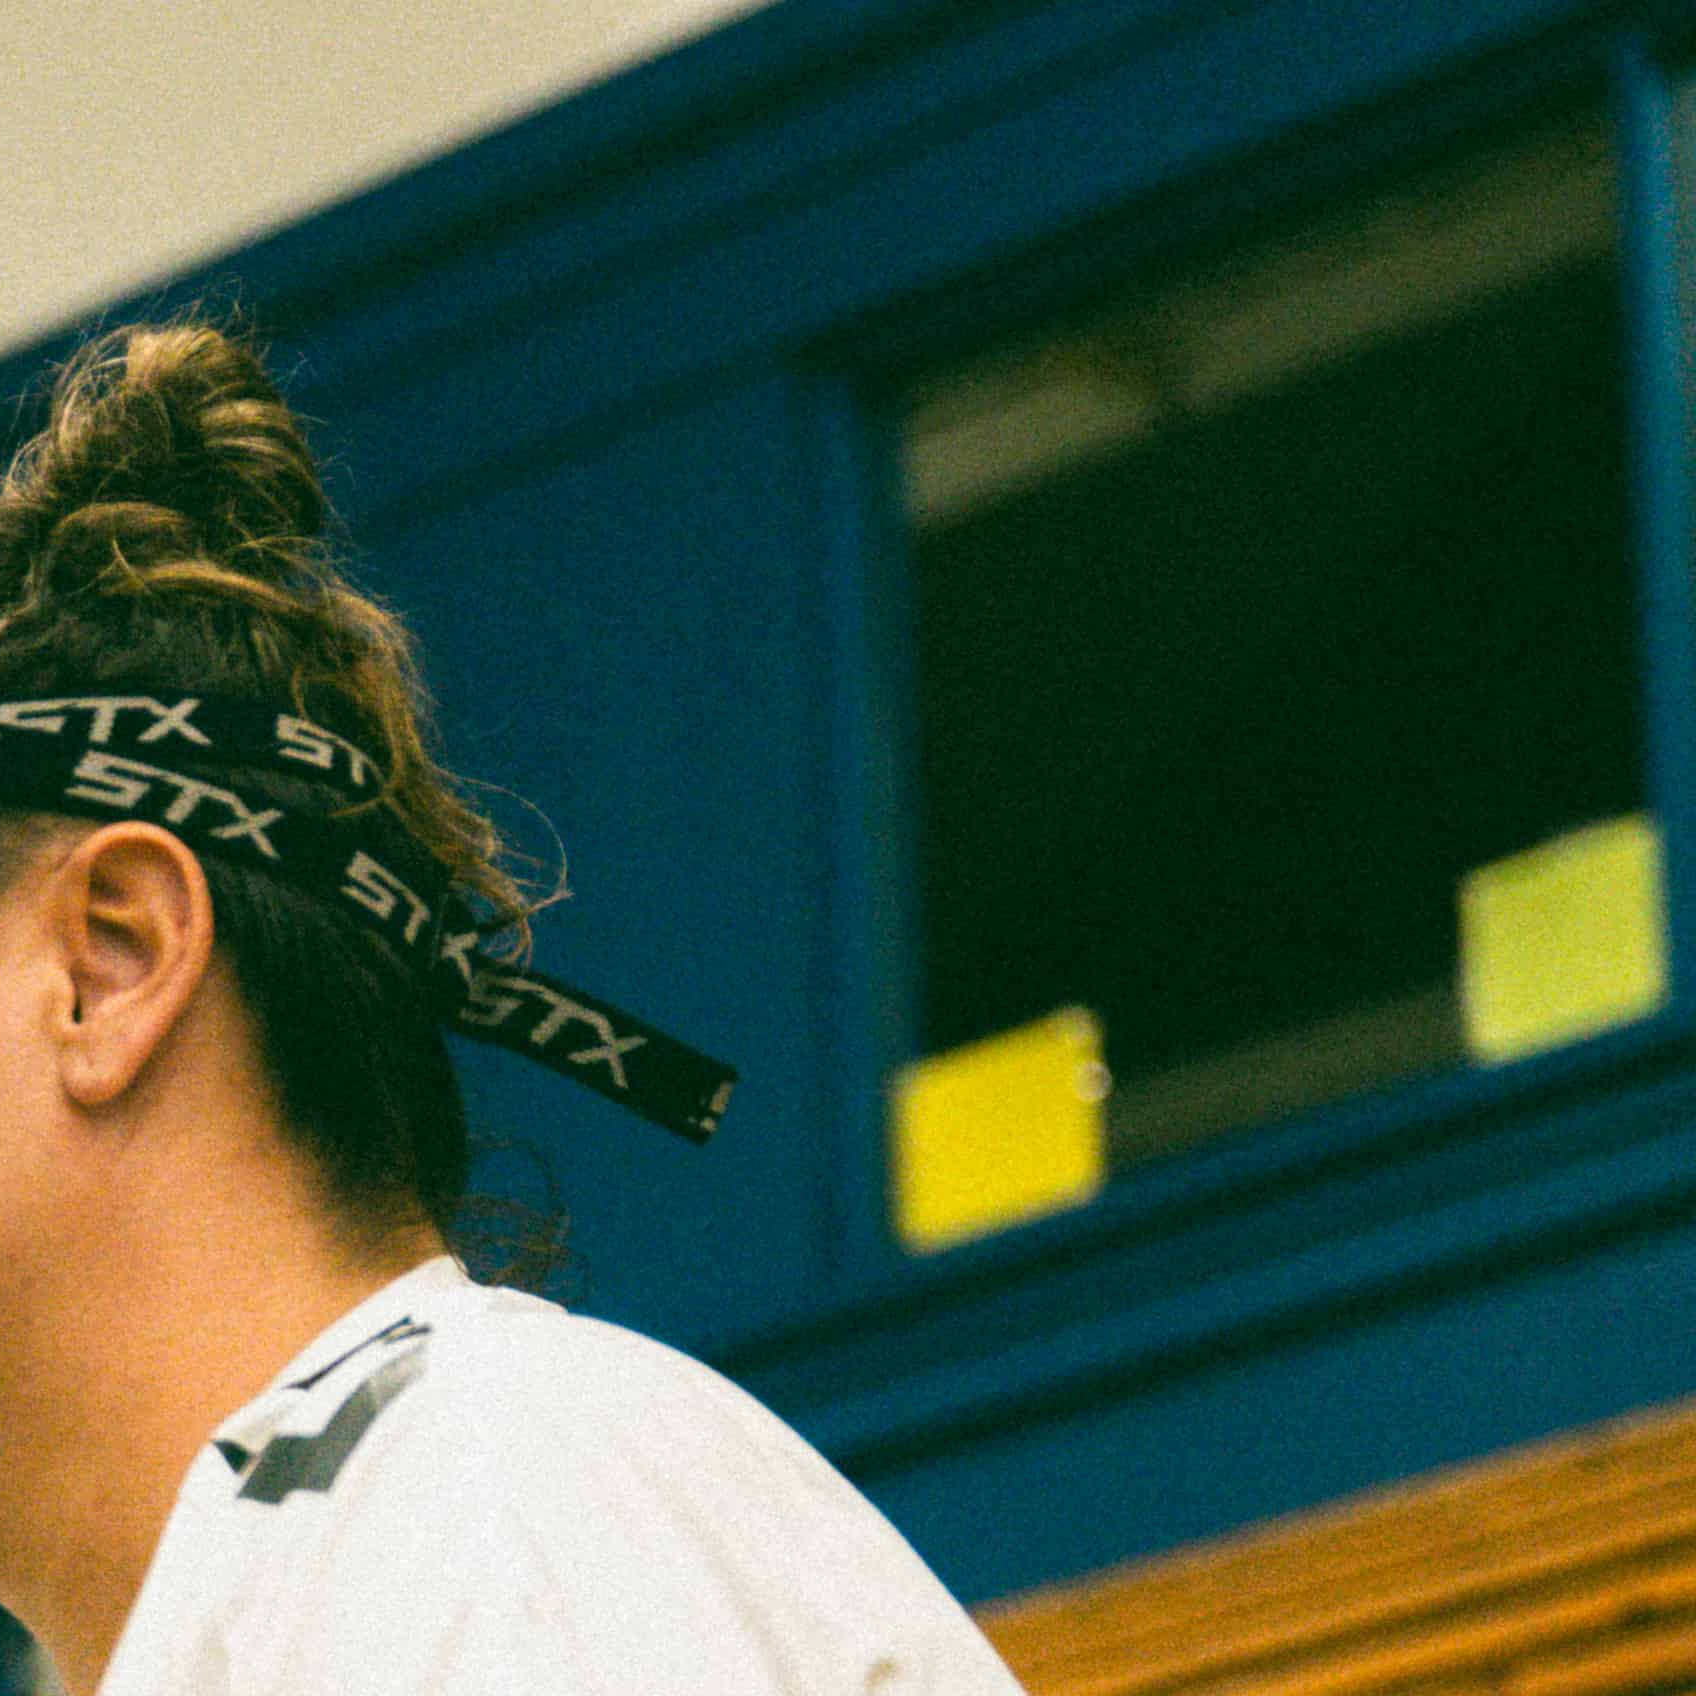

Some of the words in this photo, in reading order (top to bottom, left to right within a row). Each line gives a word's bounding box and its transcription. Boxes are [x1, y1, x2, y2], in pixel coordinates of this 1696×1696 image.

[276, 713, 384, 786] ST
[65, 750, 284, 860] STX
[459, 972, 648, 1089] STX
